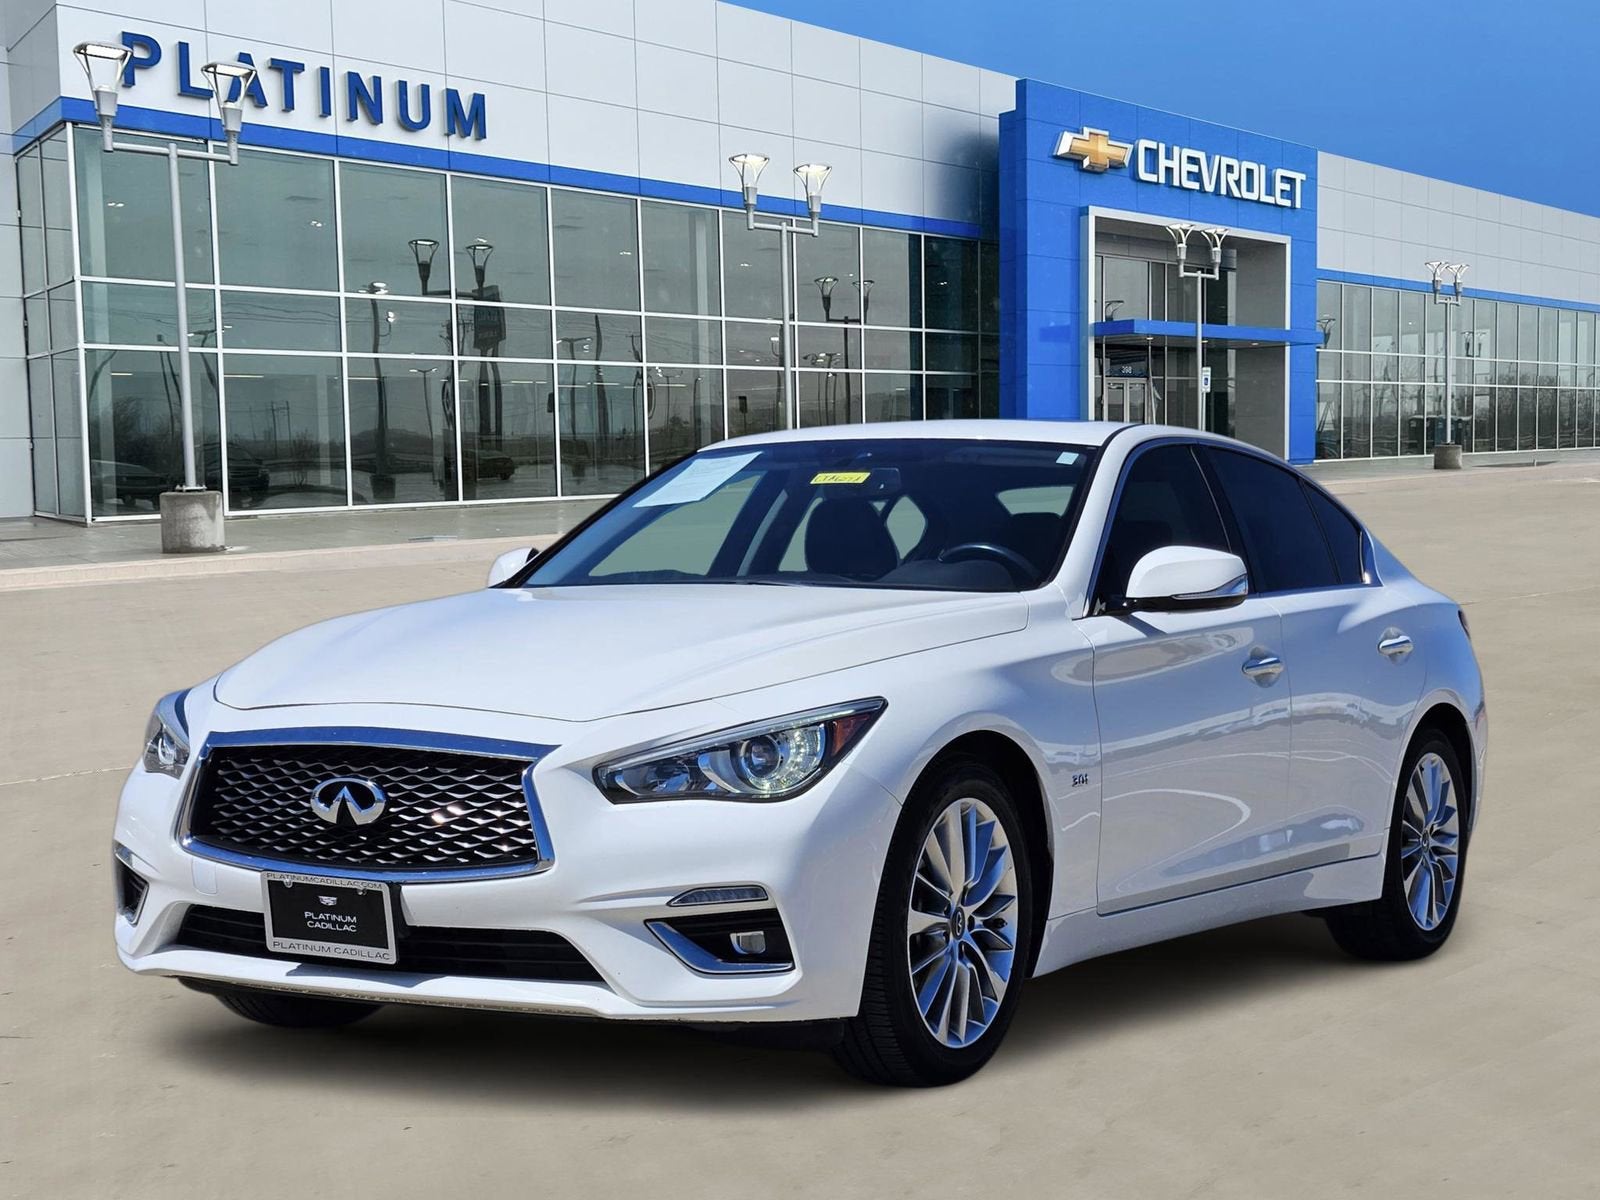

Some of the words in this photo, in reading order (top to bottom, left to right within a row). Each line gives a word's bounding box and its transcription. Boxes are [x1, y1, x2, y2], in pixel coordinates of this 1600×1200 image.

[120, 31, 487, 140] PLATINUM
[1136, 138, 1307, 209] CHEVROLET
[304, 911, 357, 923] PLATINUM
[306, 920, 357, 932] CADILLAC
[272, 941, 331, 953] PLATINUM
[333, 947, 390, 960] CADILLAC
